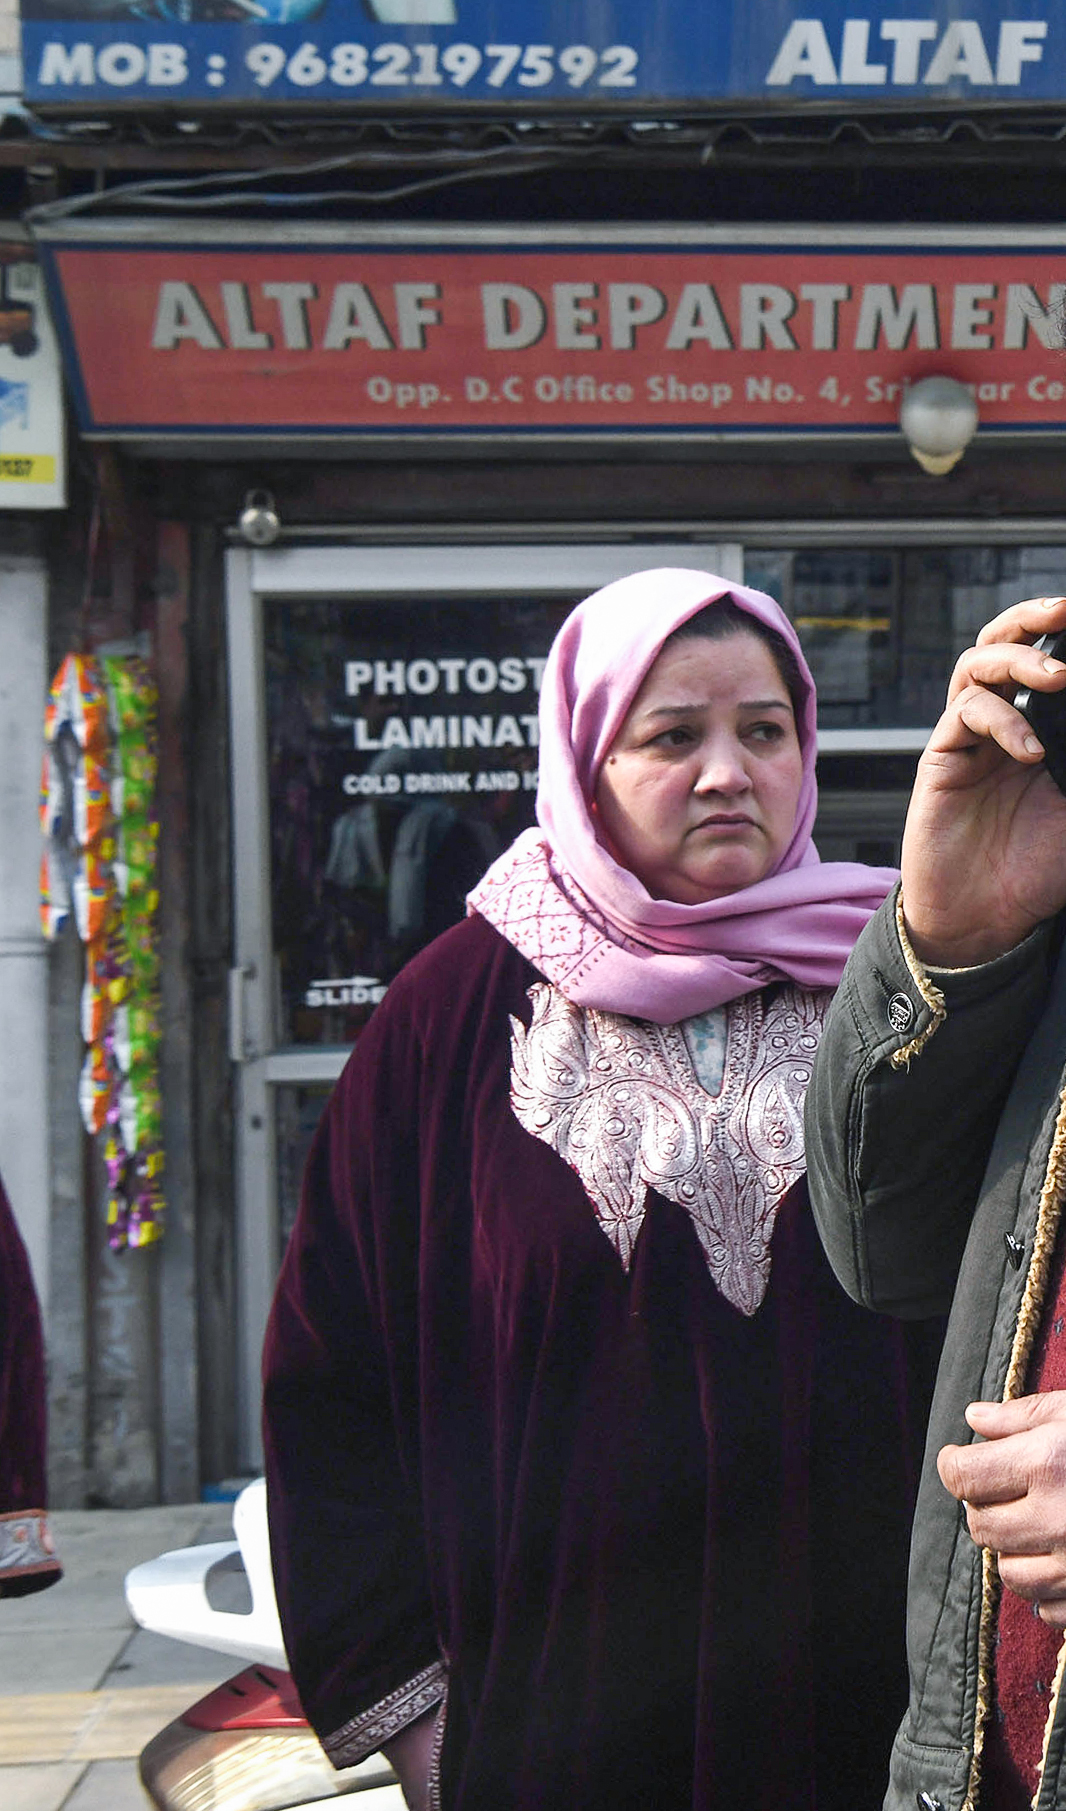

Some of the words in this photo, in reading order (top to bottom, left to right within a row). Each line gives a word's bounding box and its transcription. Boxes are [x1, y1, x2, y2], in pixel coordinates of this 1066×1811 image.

[39, 42, 188, 86] MOB
[206, 53, 225, 86] :
[245, 43, 639, 89] 9682197592
[765, 18, 1048, 86] ALTAF
[152, 281, 443, 350] ALTAF
[366, 376, 450, 409] Opp.
[465, 376, 522, 403] D.C
[534, 375, 633, 403] Office
[647, 376, 732, 409] Shop
[745, 377, 804, 403] No.
[818, 376, 850, 406] 4,
[343, 773, 401, 795] COLD
[404, 772, 471, 793] DRINK
[475, 771, 519, 792] AND
